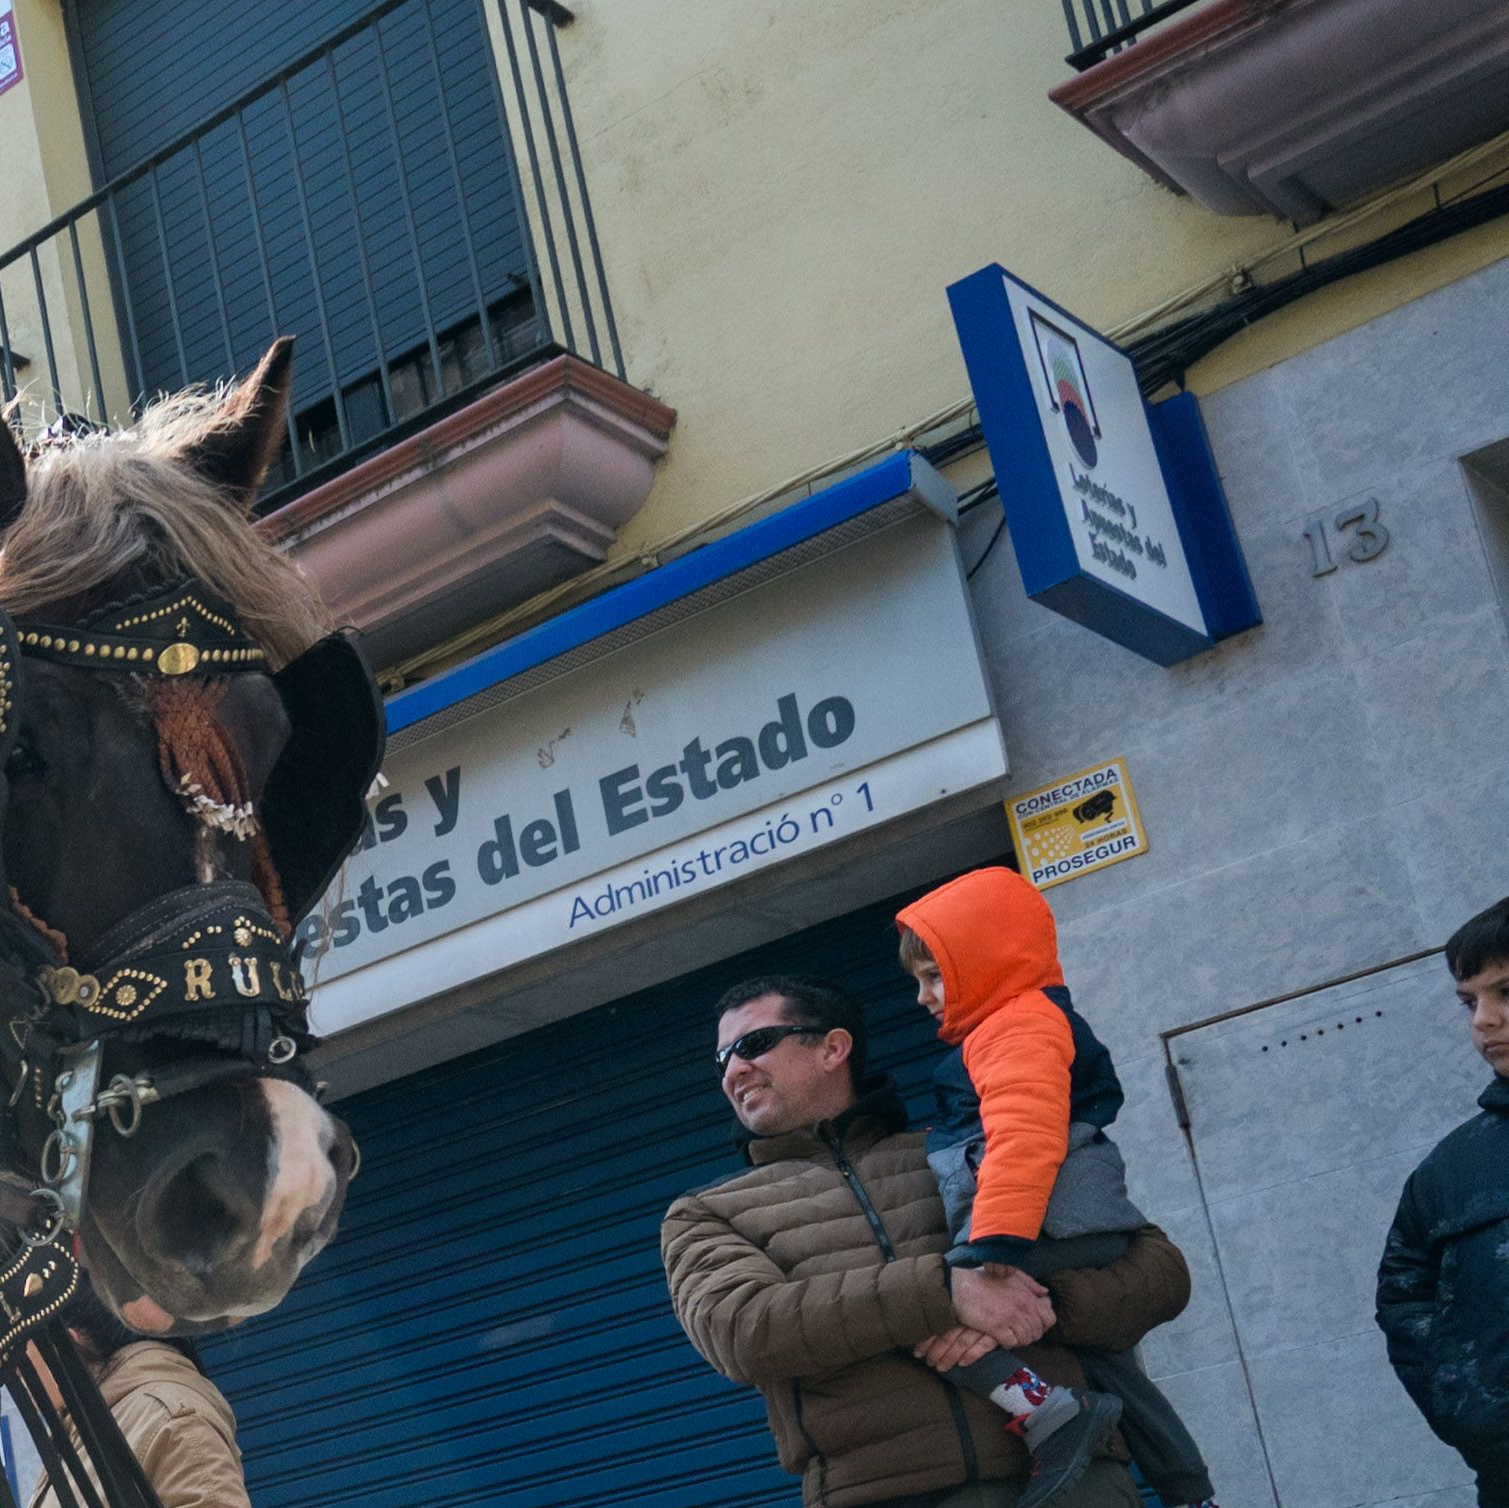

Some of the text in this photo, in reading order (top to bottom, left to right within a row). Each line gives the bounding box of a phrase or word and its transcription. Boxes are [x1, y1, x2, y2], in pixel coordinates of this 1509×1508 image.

[1126, 502, 1138, 530] y
[1302, 496, 1390, 579] 13
[1087, 530, 1138, 581] Estado
[1144, 535, 1168, 570] del
[423, 764, 462, 838] y
[475, 787, 582, 887] del
[597, 691, 856, 837] Estado
[1015, 767, 1118, 815] CONECTADA
[568, 814, 801, 929] Administració
[856, 781, 876, 813] 1
[1032, 835, 1137, 884] PROSEGUR
[1097, 828, 1128, 845] HORAS
